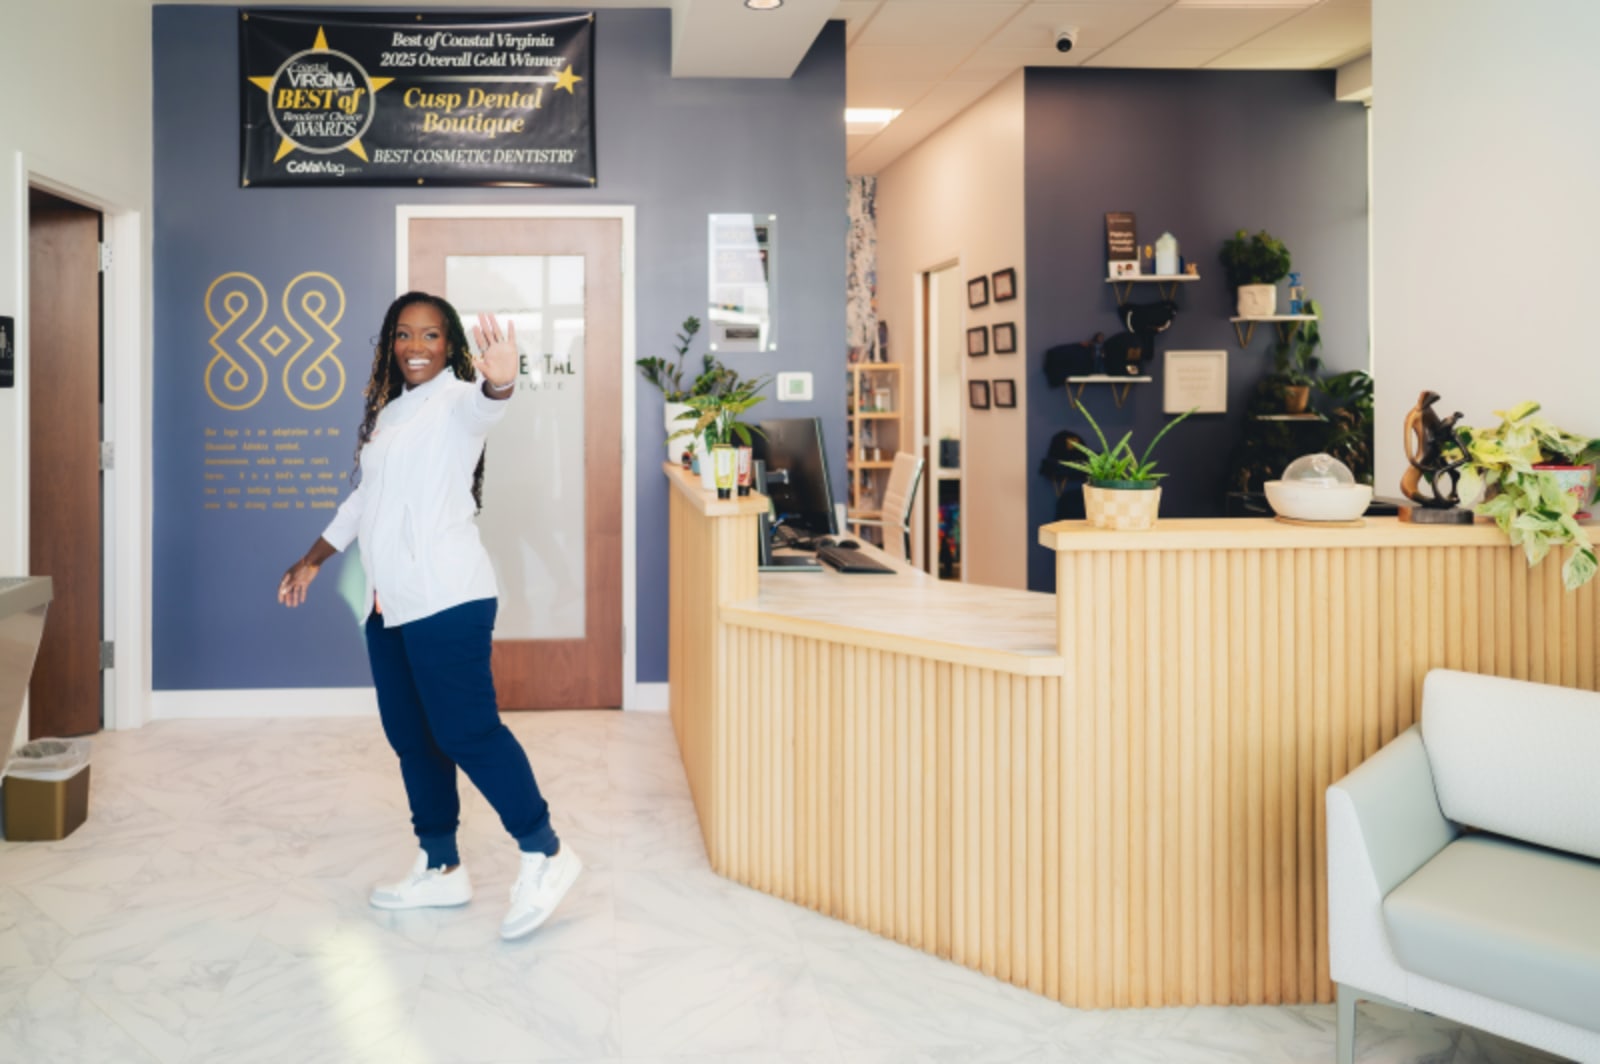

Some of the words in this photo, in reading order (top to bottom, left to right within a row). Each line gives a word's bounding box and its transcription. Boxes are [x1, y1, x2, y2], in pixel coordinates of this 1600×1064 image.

[391, 32, 422, 47] Best
[424, 32, 442, 50] of
[441, 32, 494, 47] Coastal
[496, 34, 554, 50] Virginia
[380, 52, 417, 67] 2025
[419, 52, 471, 67] Overall
[473, 52, 506, 67] Gold
[509, 53, 566, 67] Winner
[286, 68, 355, 88] VIRGINIA
[276, 88, 339, 109] BEST
[337, 87, 366, 114] of
[403, 87, 461, 113] Cusp
[467, 87, 543, 108] Dental
[290, 121, 357, 136] AWARDS
[422, 112, 525, 139] Boutique
[373, 149, 413, 163] BEST
[413, 149, 490, 163] COSMETIC
[492, 149, 577, 163] DENTISTRY
[519, 354, 576, 375] ETAL
